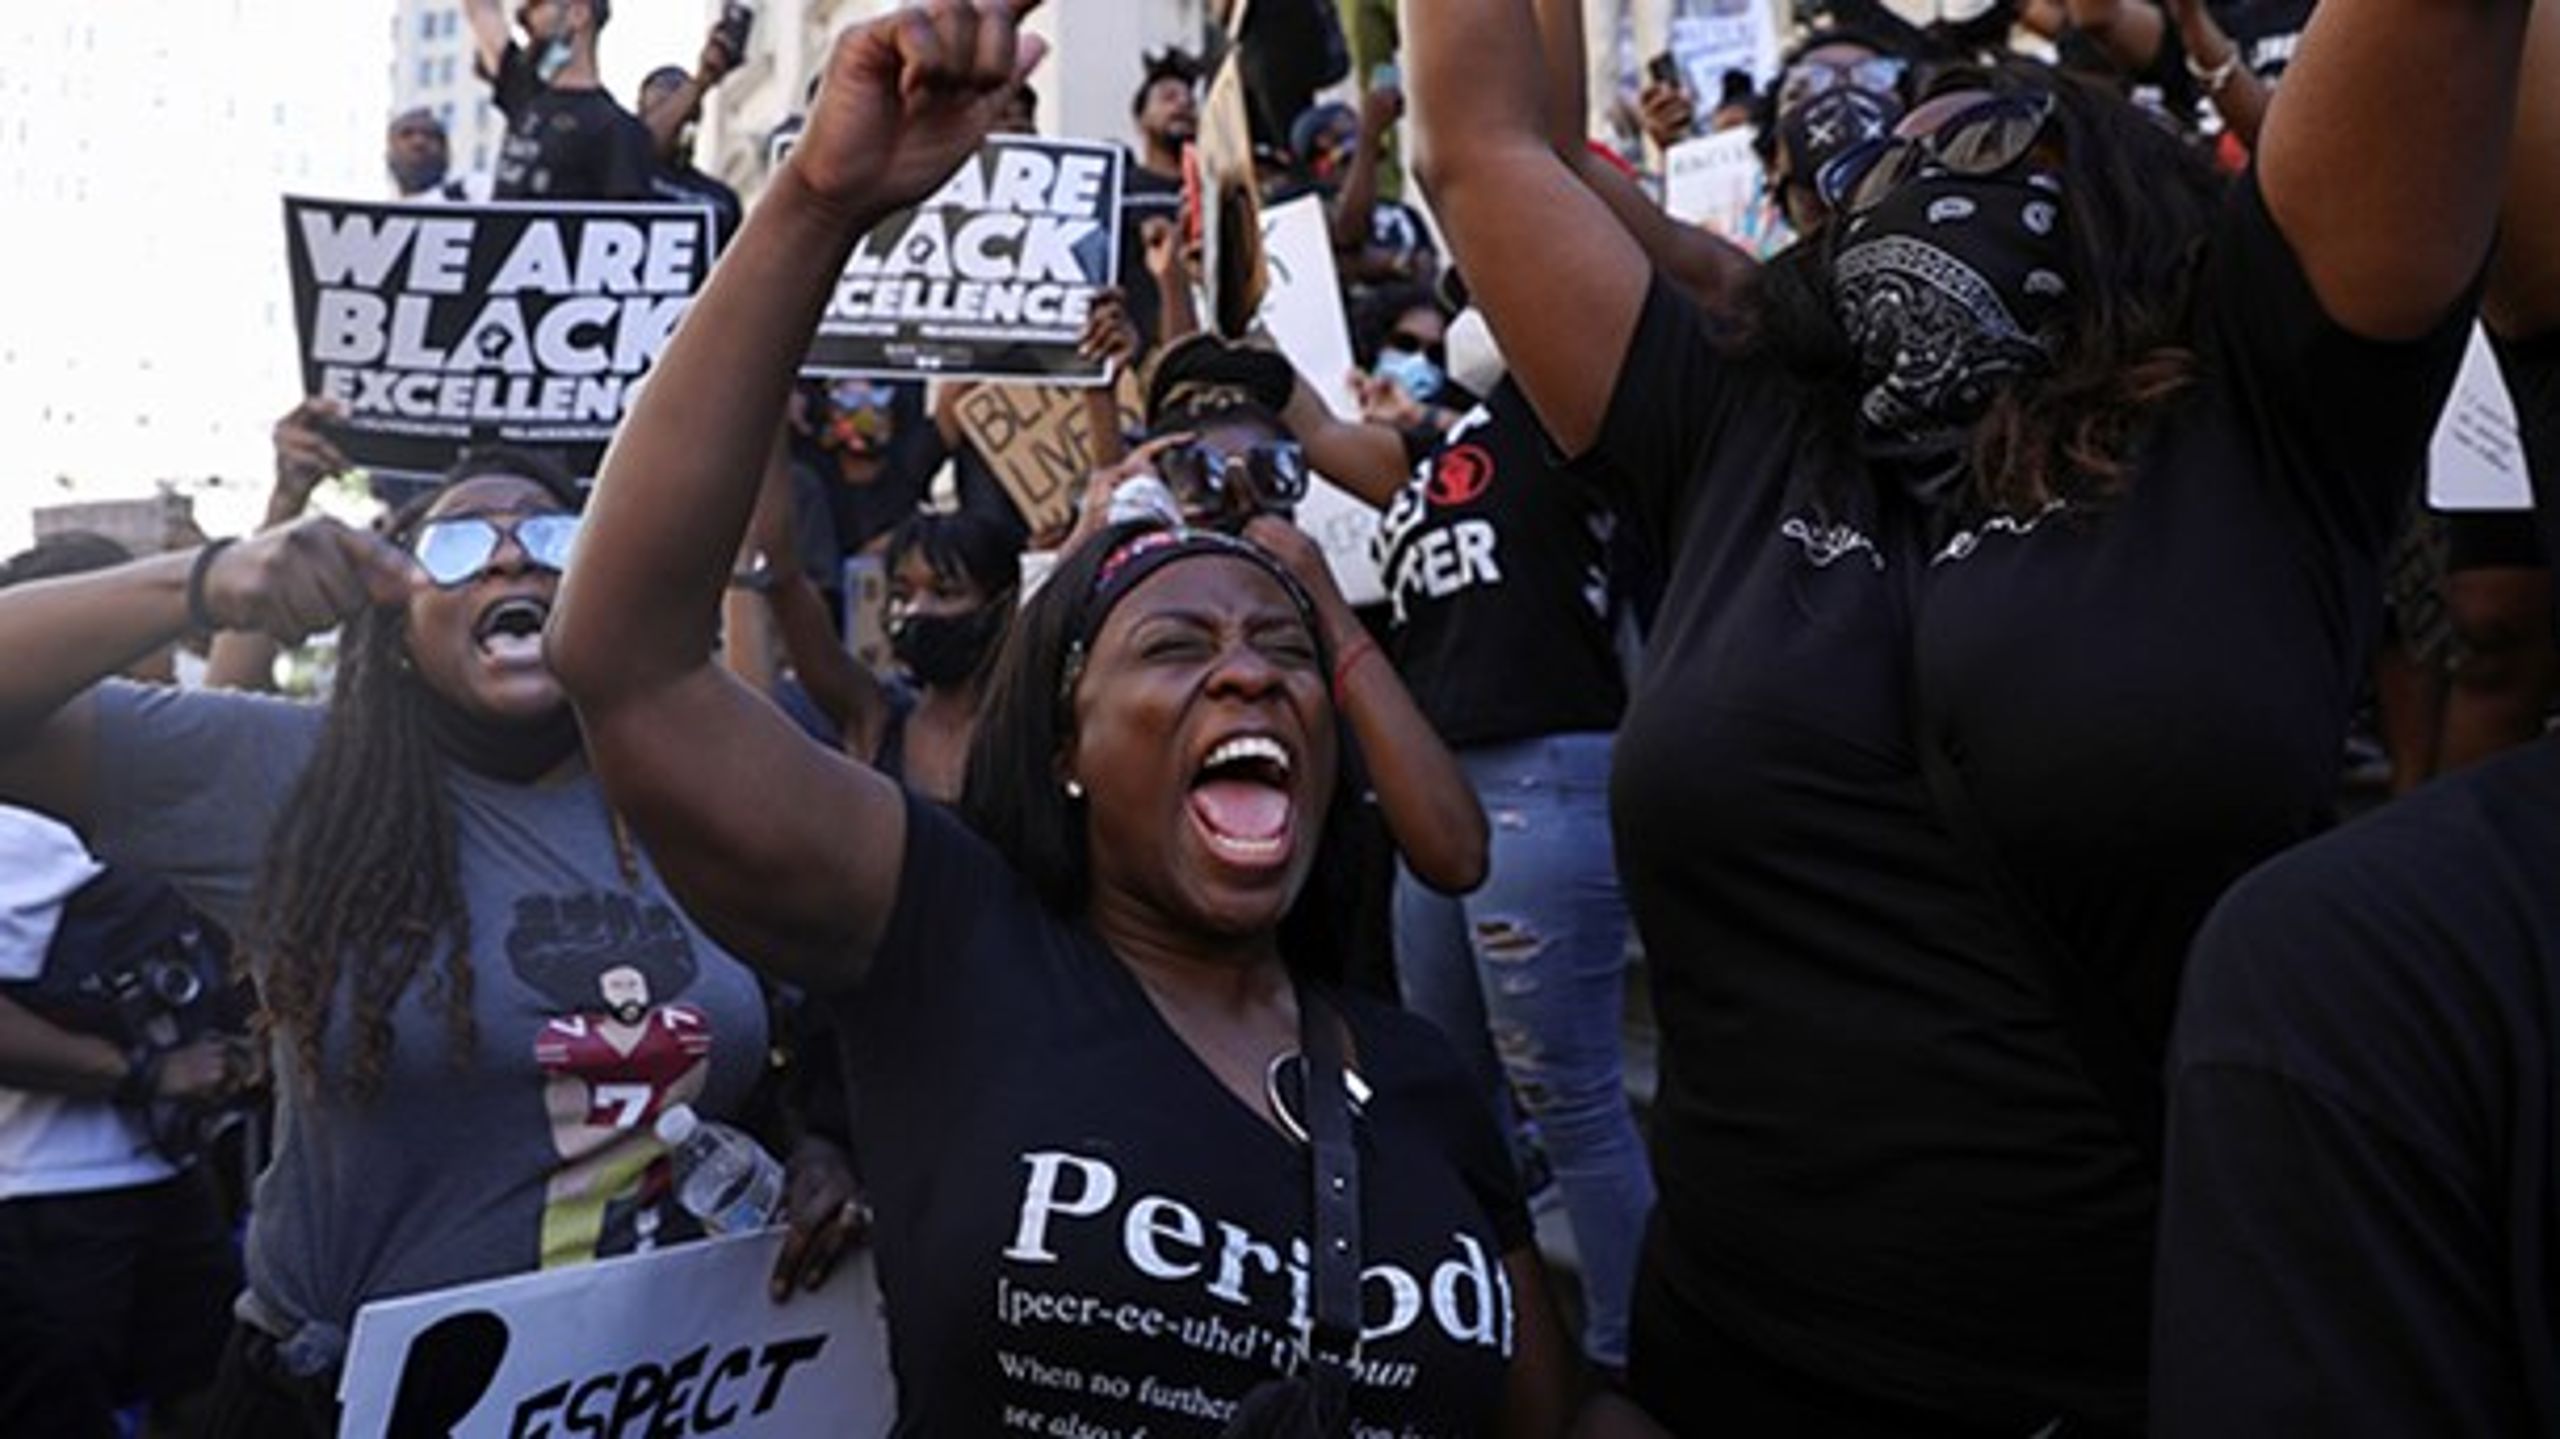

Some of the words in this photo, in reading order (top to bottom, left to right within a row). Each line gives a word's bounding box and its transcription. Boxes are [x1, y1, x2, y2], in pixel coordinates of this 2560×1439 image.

[918, 147, 1109, 217] ARE
[300, 210, 475, 293] WE
[487, 219, 699, 295] ARE
[842, 211, 1104, 284] LACK
[312, 287, 699, 376] BLACK
[824, 277, 1099, 326] CELLENCE
[322, 365, 640, 422] EXCELLEN
[594, 1083, 653, 1129] 7
[386, 1309, 830, 1439] RESPECT
[998, 1352, 1083, 1390] When
[1090, 1375, 1131, 1398] no
[1138, 1376, 1239, 1421] further
